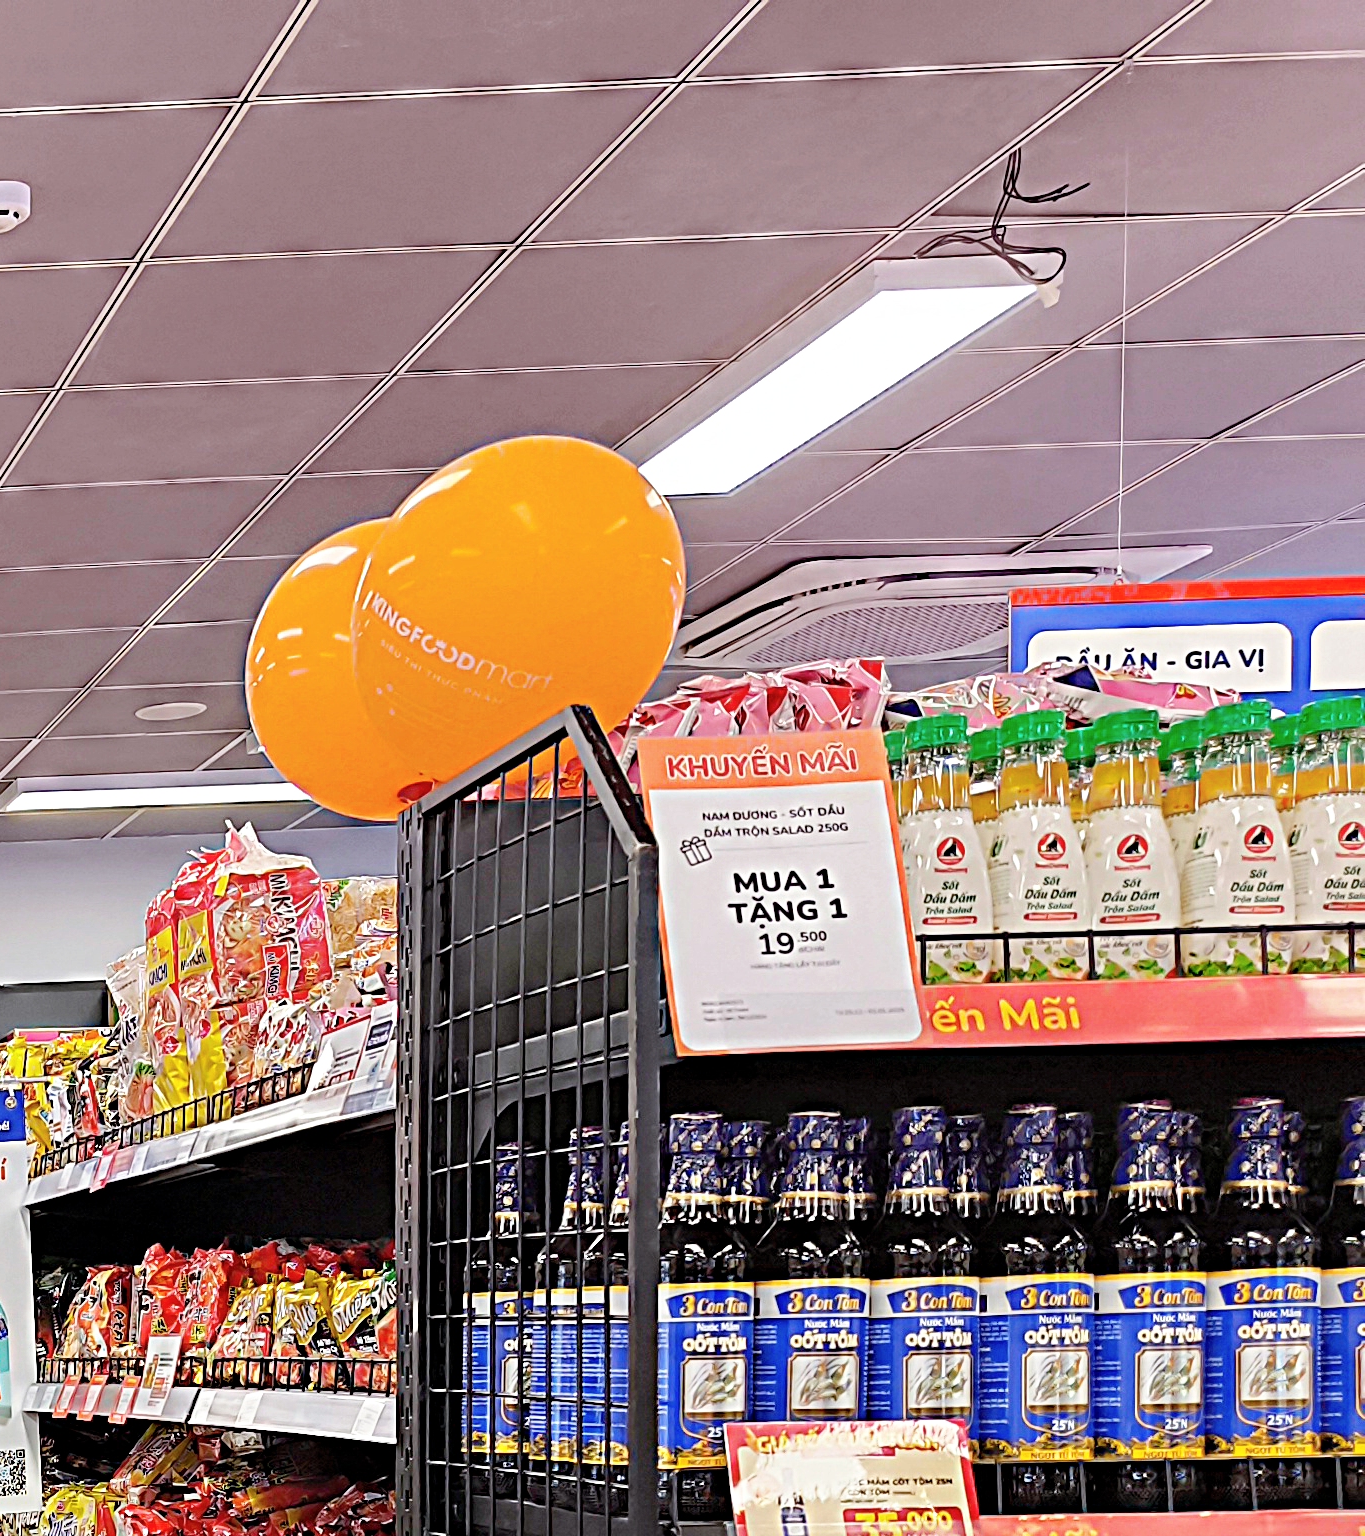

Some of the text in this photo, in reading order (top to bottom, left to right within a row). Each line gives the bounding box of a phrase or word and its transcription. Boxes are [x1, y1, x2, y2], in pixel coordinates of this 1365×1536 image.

[1185, 649, 1231, 669] GIA
[1238, 649, 1265, 672] VỊ
[668, 744, 858, 779] KHUYẾN MÃI
[702, 808, 813, 821] NAM DƯƠNG SỐT
[735, 822, 848, 837] TRỘN SALAD 250G
[734, 868, 834, 893] MUA 1
[728, 896, 847, 929] TẶNG 1
[759, 933, 794, 955] 19
[797, 931, 827, 943] .500
[788, 1292, 860, 1313] 3 Con Tôm
